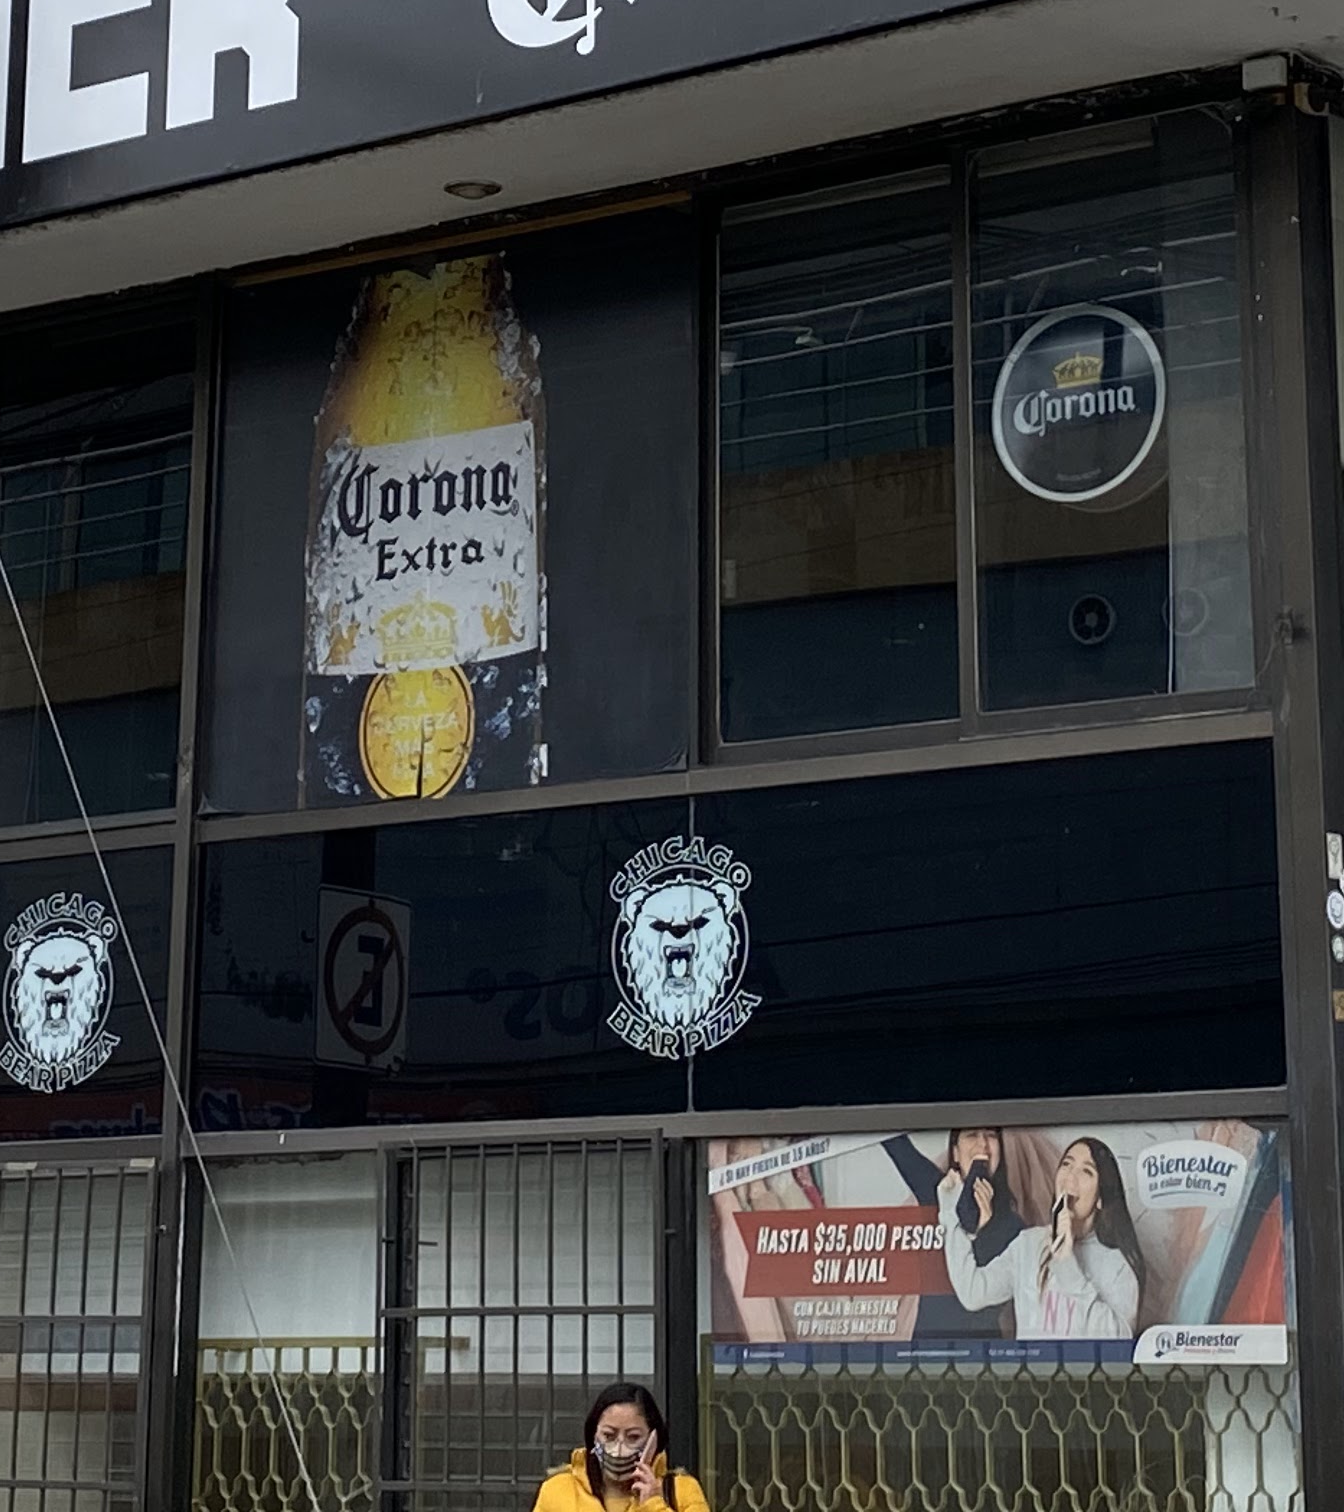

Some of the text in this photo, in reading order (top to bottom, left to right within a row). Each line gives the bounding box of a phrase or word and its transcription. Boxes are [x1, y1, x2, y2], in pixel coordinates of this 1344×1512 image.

[1013, 385, 1136, 437] Corona
[338, 456, 513, 542] Corona
[376, 535, 485, 581] Extra
[609, 835, 752, 902] CHICAGO
[4, 892, 118, 951] CHICAGO
[607, 1002, 679, 1060] BEAR
[684, 990, 762, 1056] PIZZA
[56, 1030, 121, 1091] PIZZA
[752, 1156, 778, 1175] FIESTA
[1143, 1154, 1237, 1177] Bienestar
[757, 1222, 945, 1256] HASTA $35,000 PESOS
[812, 1257, 888, 1284] SIN AVAL
[815, 1301, 841, 1316] CAJA
[843, 1299, 899, 1316] BIENESTAR
[1175, 1330, 1241, 1347] Bienestar
